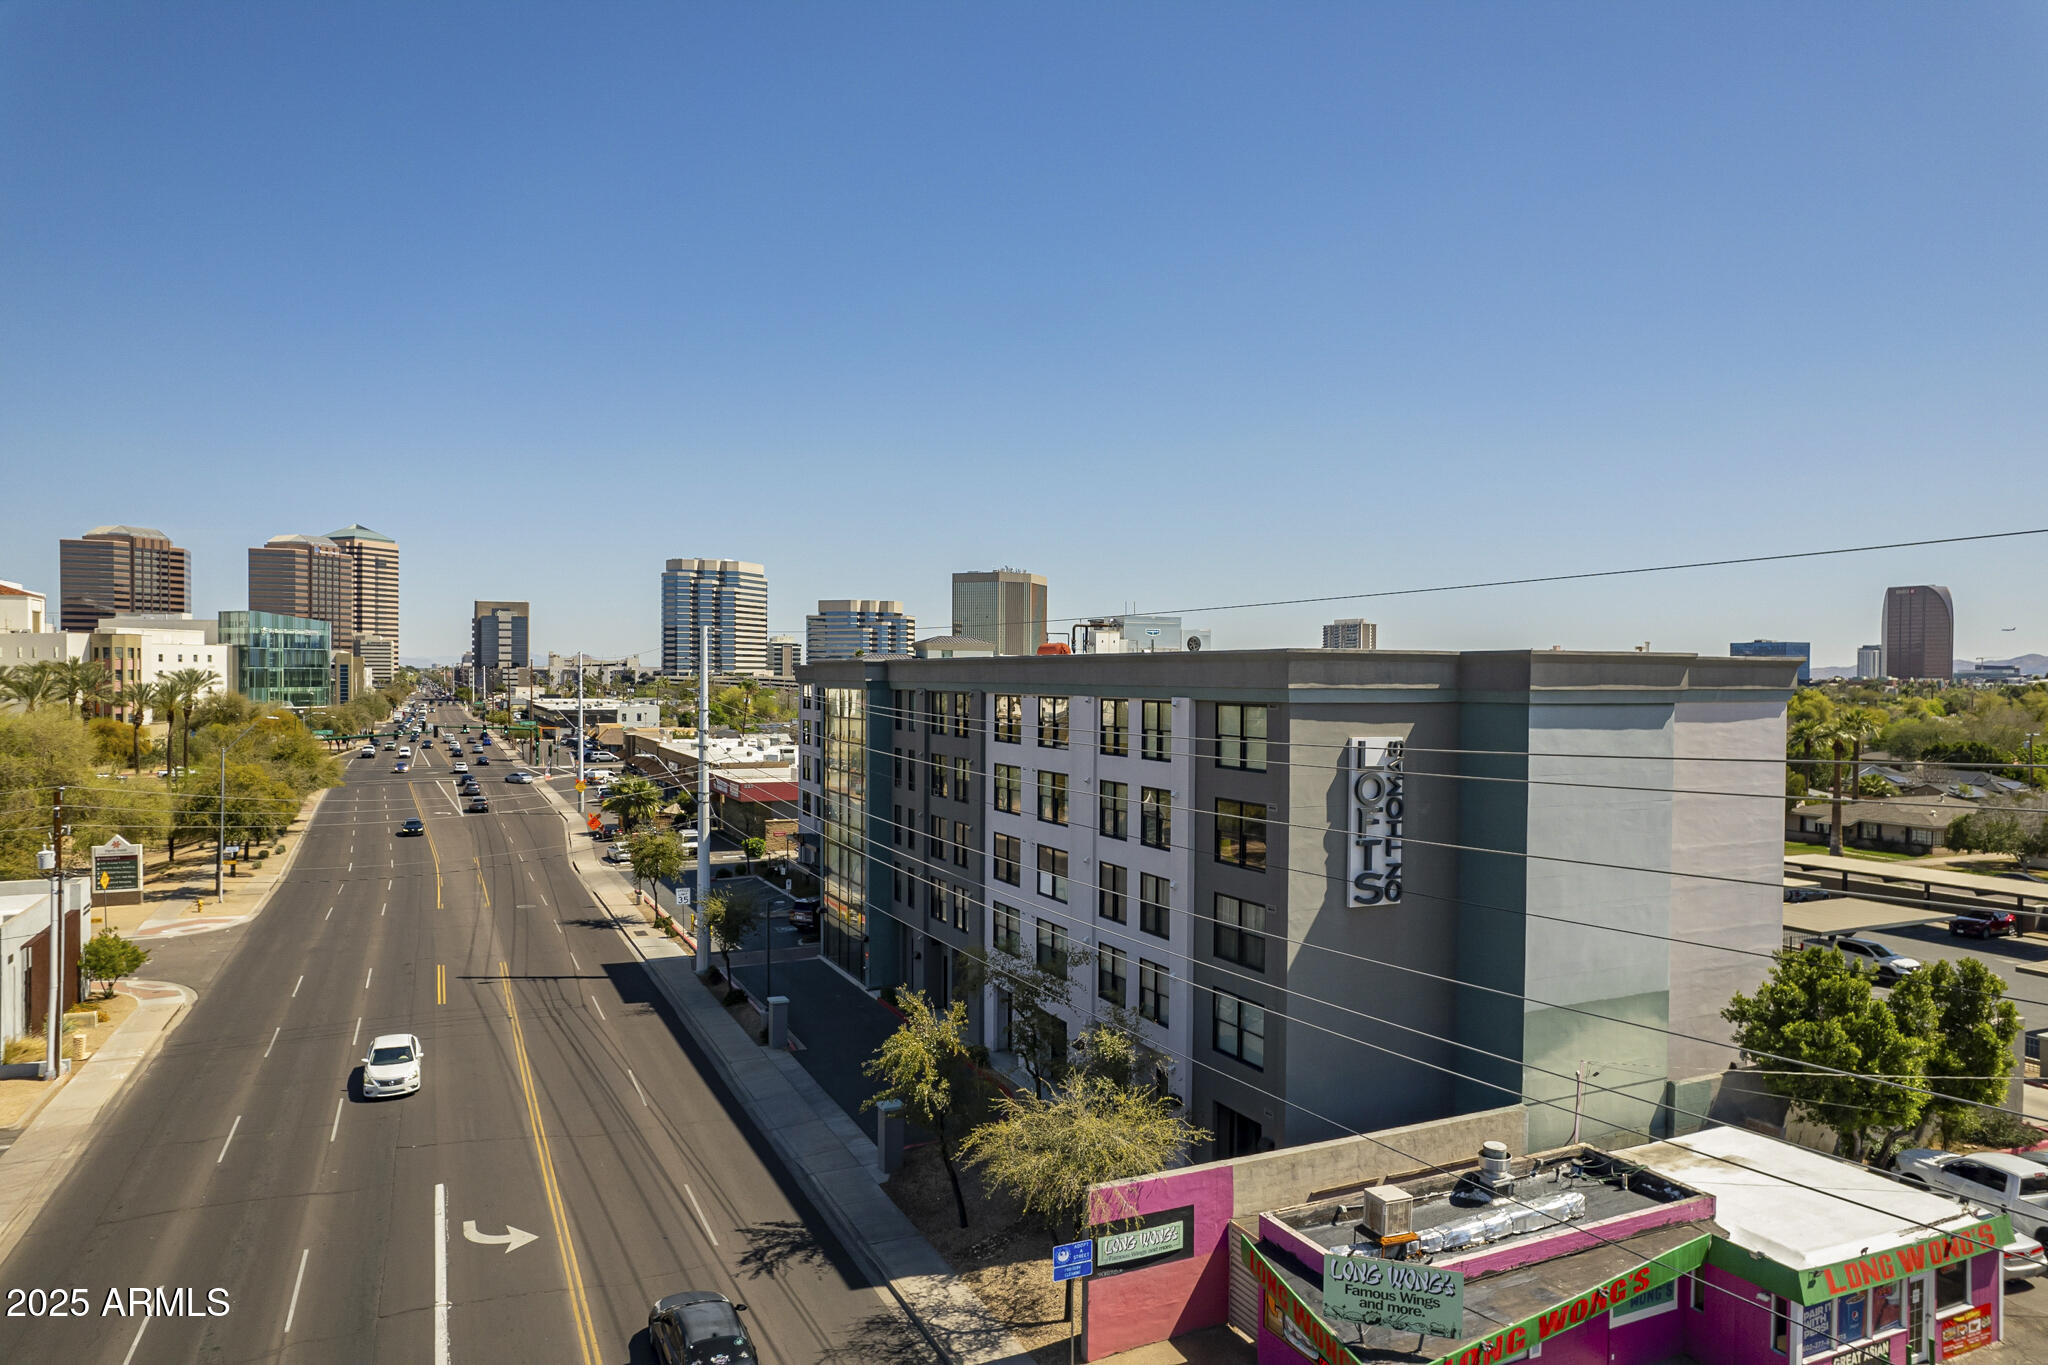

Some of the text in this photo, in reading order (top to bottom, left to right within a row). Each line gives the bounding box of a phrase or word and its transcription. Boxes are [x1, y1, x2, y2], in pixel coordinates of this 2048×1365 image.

[1385, 740, 1405, 857] THOMAS
[1353, 740, 1386, 905] LOFTS
[678, 896, 689, 904] 35
[1073, 1252, 1090, 1260] STREET
[1104, 1235, 1137, 1255] LONG
[1330, 1258, 1384, 1286] LONG
[1823, 1224, 1996, 1295] LONG WONG'S
[1250, 1250, 1289, 1312] LONG
[1344, 1284, 1441, 1310] Famous Wings
[1359, 1298, 1426, 1318] and more.
[1538, 1267, 1651, 1339] WONG'S
[1804, 1305, 1824, 1321] PAIR
